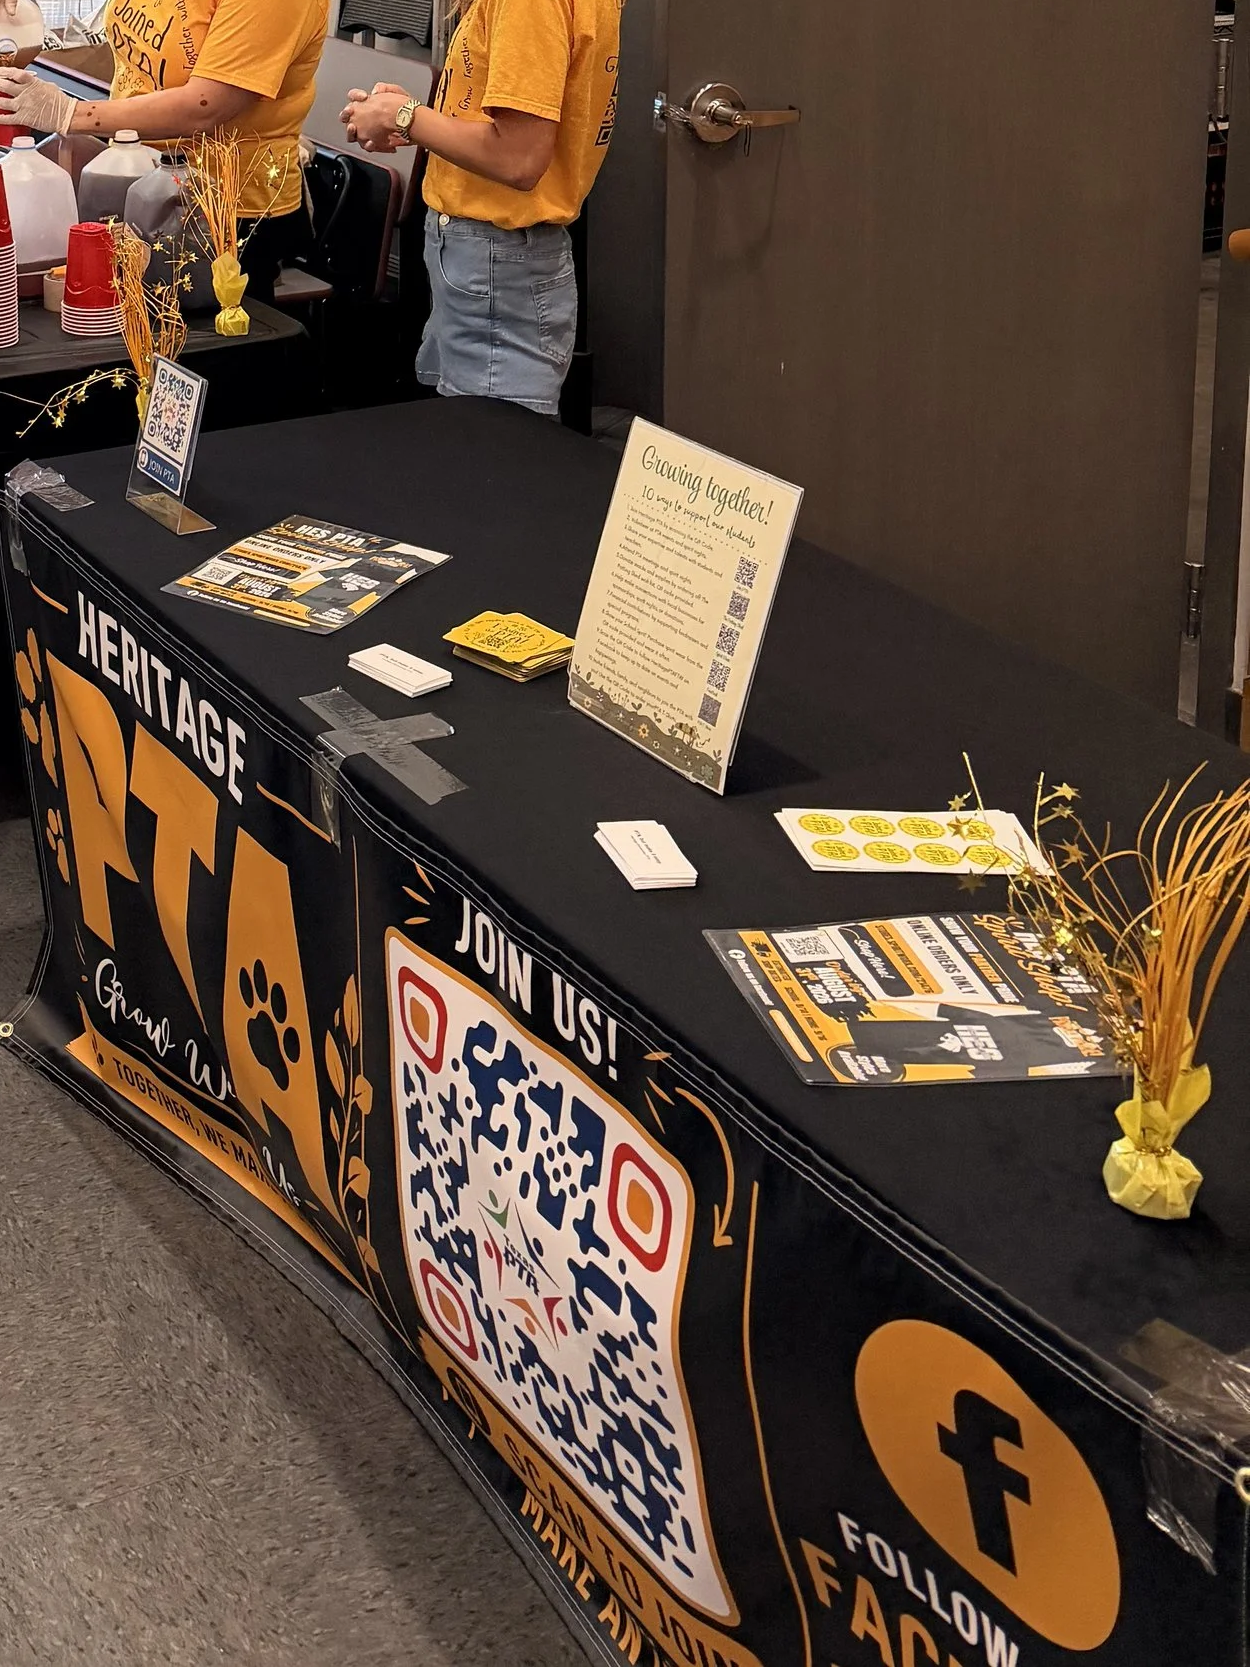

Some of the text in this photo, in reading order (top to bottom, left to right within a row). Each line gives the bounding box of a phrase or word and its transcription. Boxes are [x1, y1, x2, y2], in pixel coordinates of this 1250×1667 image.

[112, 21, 166, 91] PTA!
[179, 26, 199, 71] Together
[458, 86, 473, 111] Grow
[147, 458, 175, 485] JOIN PTA
[642, 445, 774, 526] Growing together!
[296, 524, 367, 548] HES PTA
[642, 485, 655, 501] 10
[656, 494, 674, 512] ways
[674, 499, 682, 512] to
[683, 508, 710, 528] support
[726, 525, 756, 549] students
[237, 578, 282, 594] AUGUST
[78, 590, 246, 806] HERITAGE
[45, 647, 348, 1232] PTA
[853, 938, 872, 958] Shop
[907, 920, 979, 995] ONLINE ORDERS ONLY
[972, 913, 1033, 963] Spirit
[1017, 960, 1089, 1012] Shop!
[95, 958, 176, 1057] Grow
[455, 896, 618, 1082] JOIN US!
[807, 983, 834, 1005] 2026
[813, 967, 858, 1003] AUGUST
[952, 1024, 1004, 1061] HES
[113, 1056, 200, 1137] TOGETHER,
[199, 1118, 230, 1155] WE
[503, 1233, 535, 1274] Texas
[503, 1245, 540, 1297] PTA
[504, 1433, 644, 1610] SCAN TO
[520, 1488, 643, 1666] MAKE AN
[837, 1511, 1020, 1667] FOLLOW
